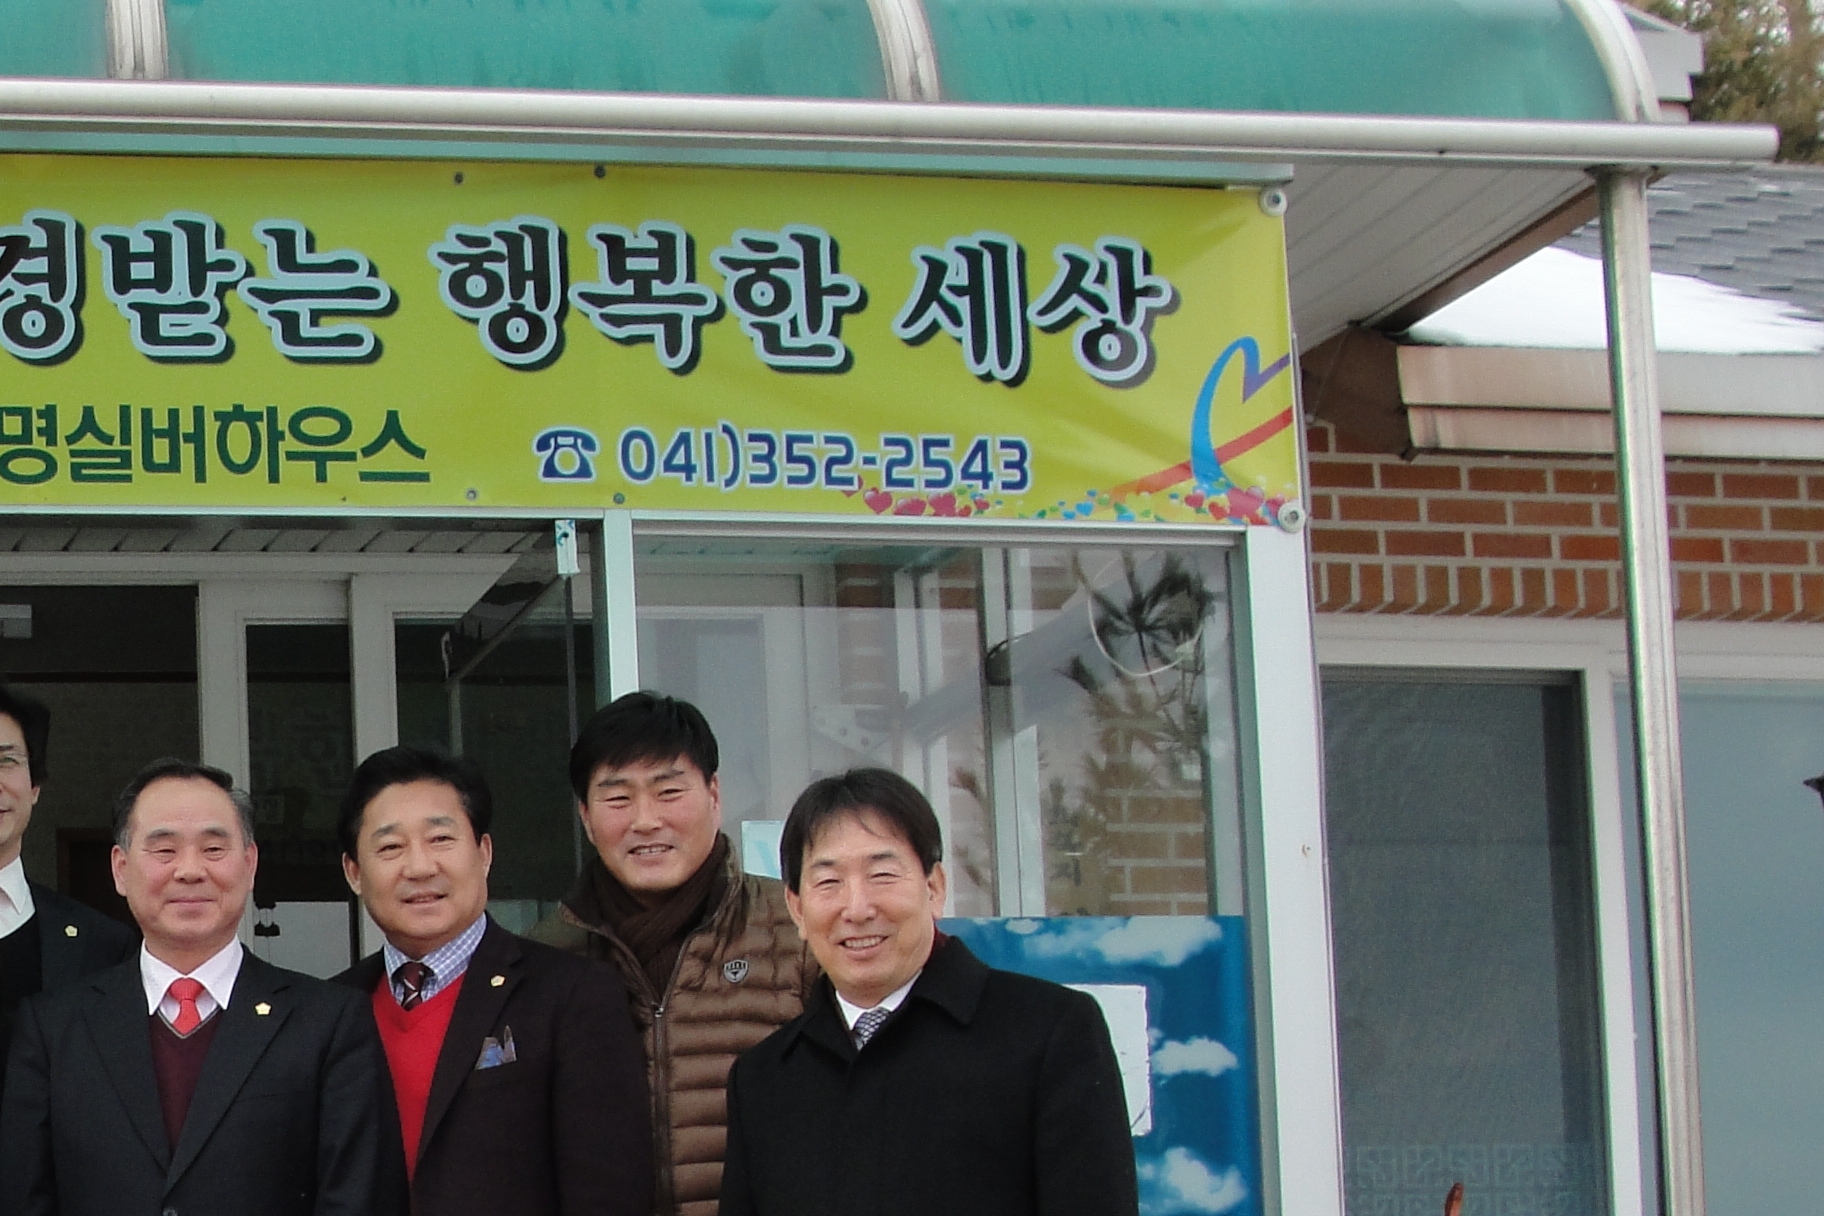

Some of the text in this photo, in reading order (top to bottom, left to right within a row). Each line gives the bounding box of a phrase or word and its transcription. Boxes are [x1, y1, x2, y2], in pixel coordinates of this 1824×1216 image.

[427, 214, 866, 374] 행복한
[892, 231, 1178, 387] 세상
[618, 419, 1034, 496] 041)352-2543
